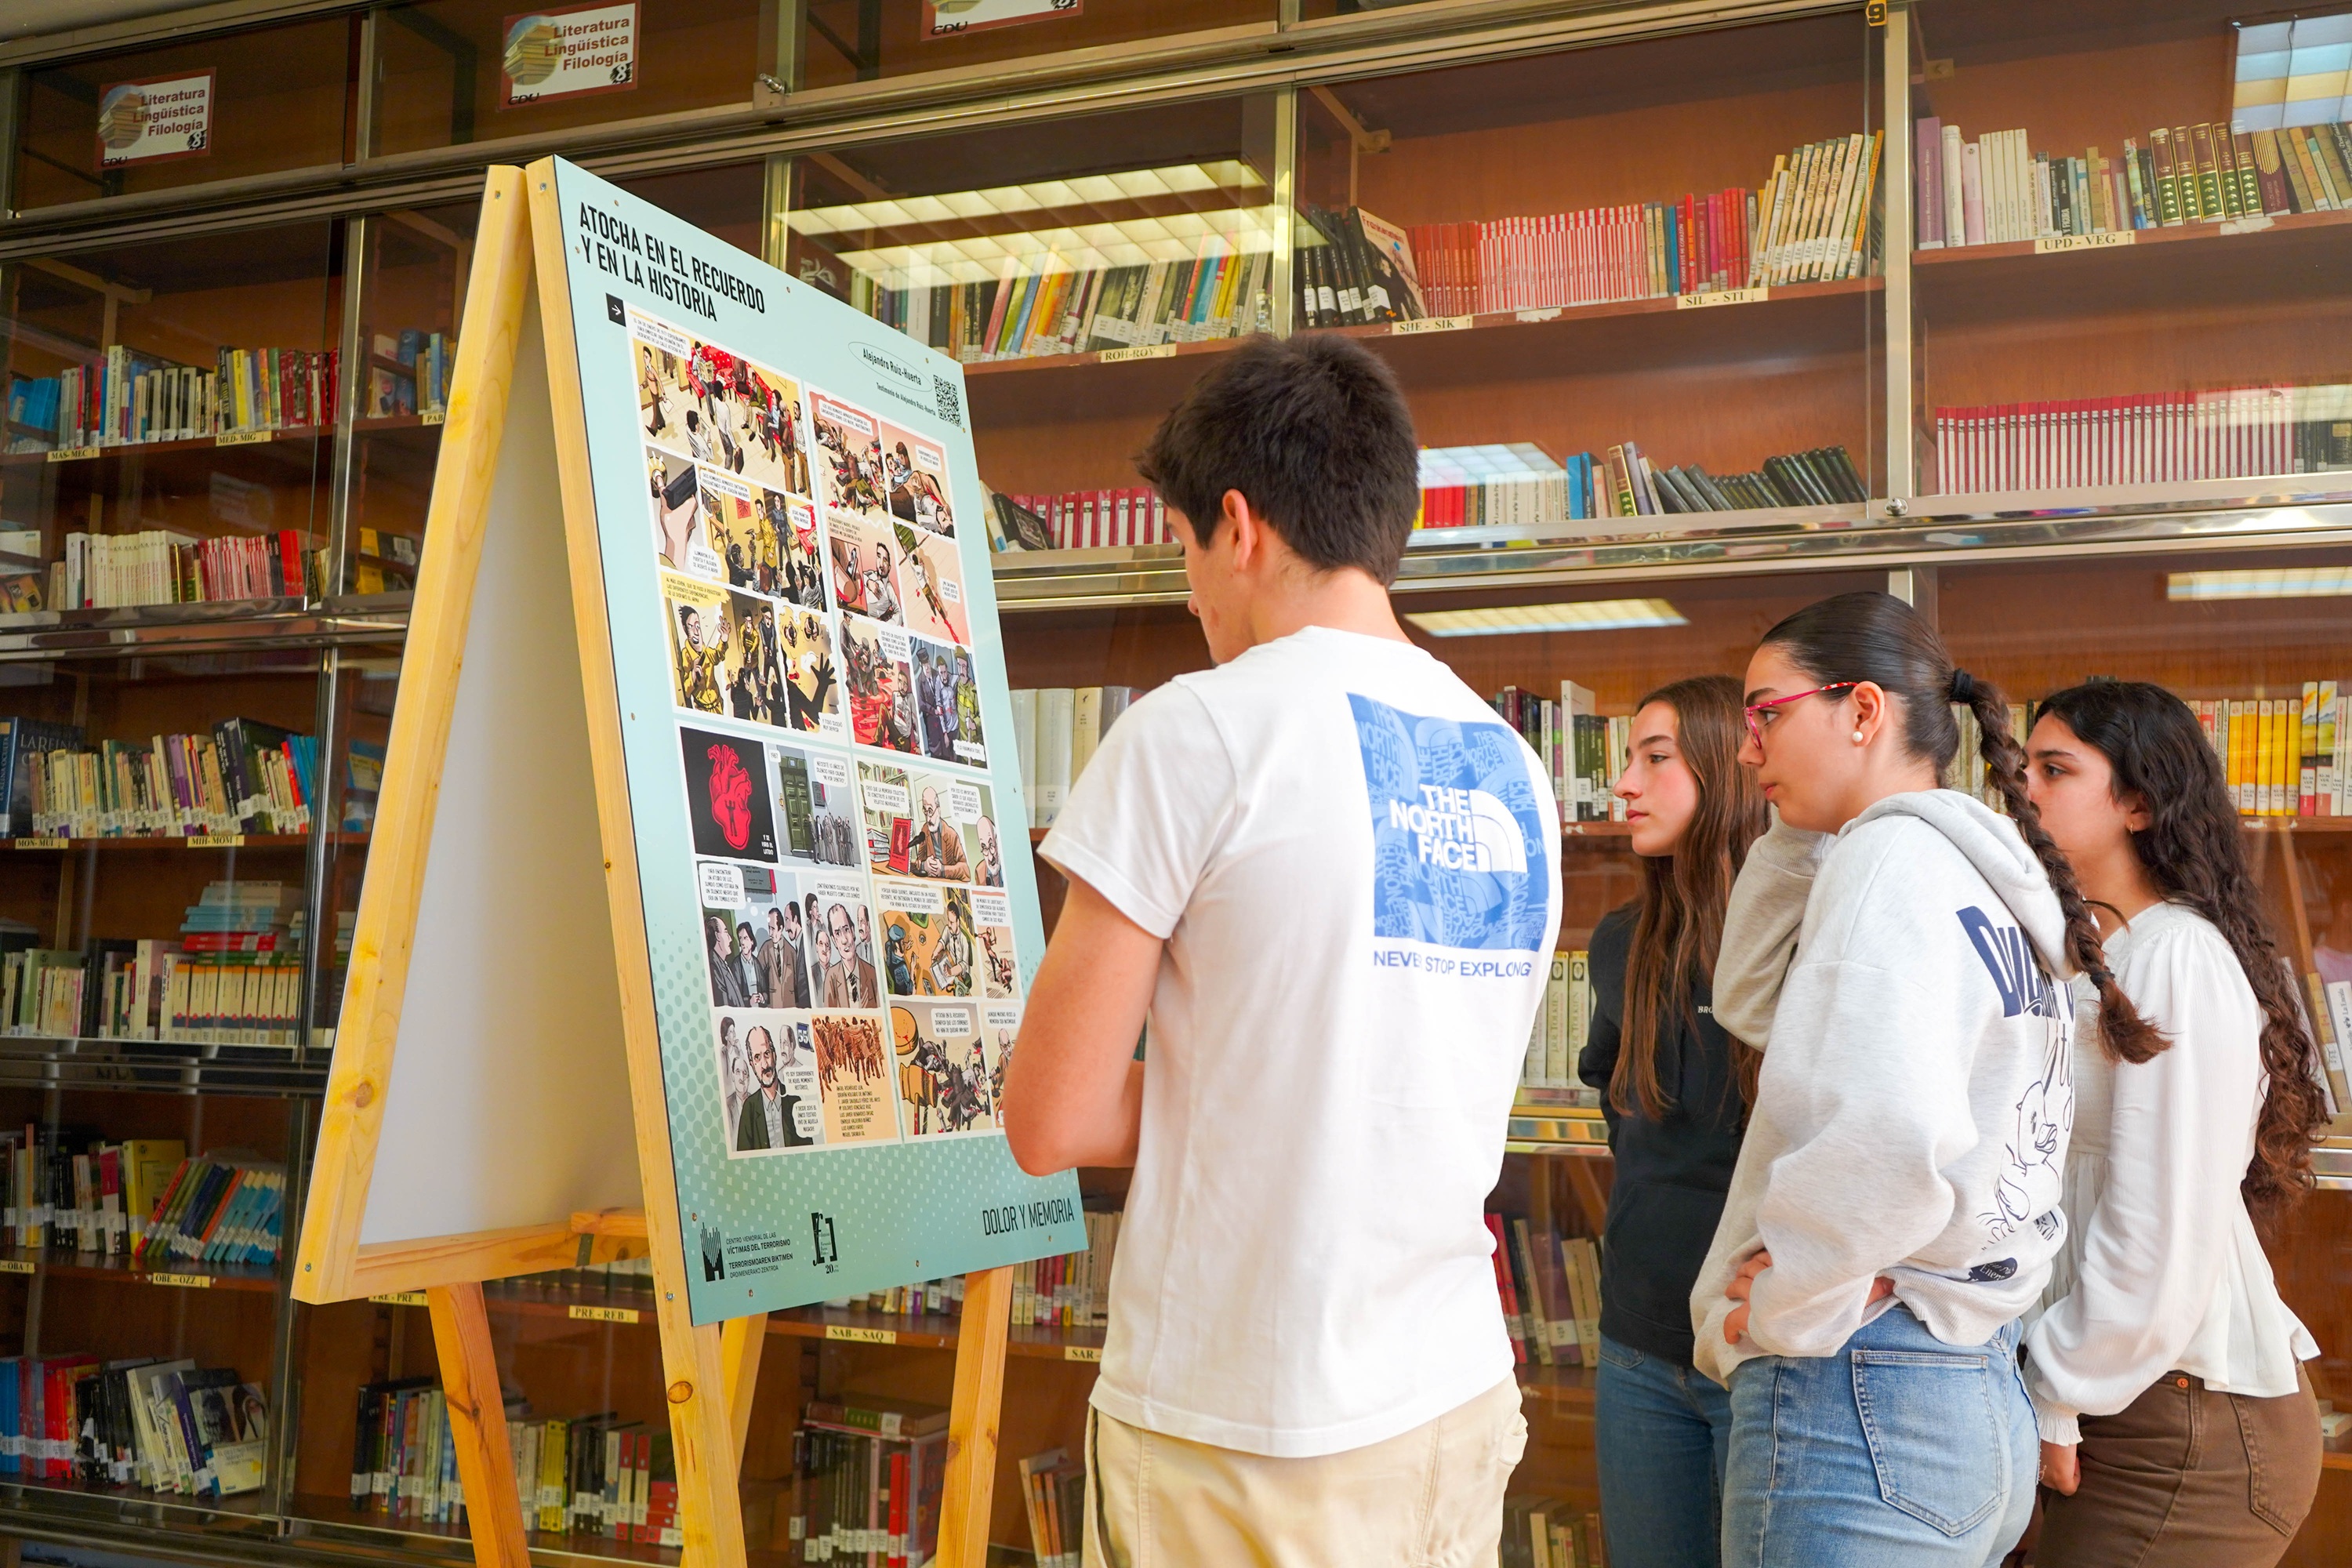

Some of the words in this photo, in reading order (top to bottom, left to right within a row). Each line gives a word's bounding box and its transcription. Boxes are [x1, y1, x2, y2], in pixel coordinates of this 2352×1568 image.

[554, 19, 630, 38] Literatura
[931, 21, 967, 35] CDU
[545, 35, 629, 56] Lingüística
[563, 52, 628, 71] Filología
[616, 64, 626, 82] 8
[141, 89, 205, 106] Literatura
[508, 93, 539, 105] CDU
[132, 105, 204, 123] Lingüística
[148, 121, 203, 136] Filología
[192, 132, 201, 147] 8
[101, 156, 127, 167] CDU
[1361, 213, 1404, 245] Frankenstein
[2044, 238, 2071, 250] UPD
[2086, 234, 2116, 247] VEG
[580, 201, 642, 256] ATOCHA
[645, 233, 666, 267] EN
[670, 245, 688, 278] EL
[691, 256, 765, 314] RECUERDO
[581, 234, 590, 264] Y
[597, 241, 619, 277] EN
[622, 254, 644, 289] LA
[648, 266, 717, 321] HISTORIA
[1686, 296, 1706, 306] SIL
[1723, 292, 1746, 303] STI
[1399, 321, 1421, 332] SHE
[1434, 319, 1455, 330] SIK
[863, 348, 889, 369] Alejandro
[890, 361, 922, 386] Ruiz-Huerta
[877, 382, 895, 397] Testimonio
[895, 391, 900, 400] de
[901, 394, 916, 407] Alejandro
[916, 401, 936, 416] Ruiz-Huerta
[427, 414, 444, 423] PAB
[240, 434, 256, 442] MIG
[1420, 784, 1470, 816] THE
[1389, 799, 1475, 844] NORTH
[1417, 839, 1478, 872] FACE
[1425, 956, 1455, 975] STOP
[1460, 961, 1532, 978] EXPLONG
[797, 1029, 809, 1044] 55
[982, 1205, 1018, 1236] DOLOR
[1018, 1203, 1027, 1230] Y
[1027, 1196, 1074, 1229] MEMORIA
[742, 1234, 763, 1243] MEMORIAL
[727, 1244, 750, 1255] VÍCTIMAS
[760, 1239, 791, 1250] TERRORISMO
[728, 1256, 771, 1269] TERRORISMOAREN
[771, 1252, 793, 1262] BIKTIMEN
[729, 1267, 760, 1279] OROIMENERAKO
[760, 1264, 779, 1273] ZENTROA
[826, 1264, 833, 1274] 20
[180, 1276, 197, 1285] OZZ
[575, 1308, 593, 1318] PRE
[604, 1310, 625, 1320] REB
[832, 1328, 852, 1338] SAB
[863, 1330, 884, 1341] SAQ
[1073, 1349, 1094, 1359] SAR
